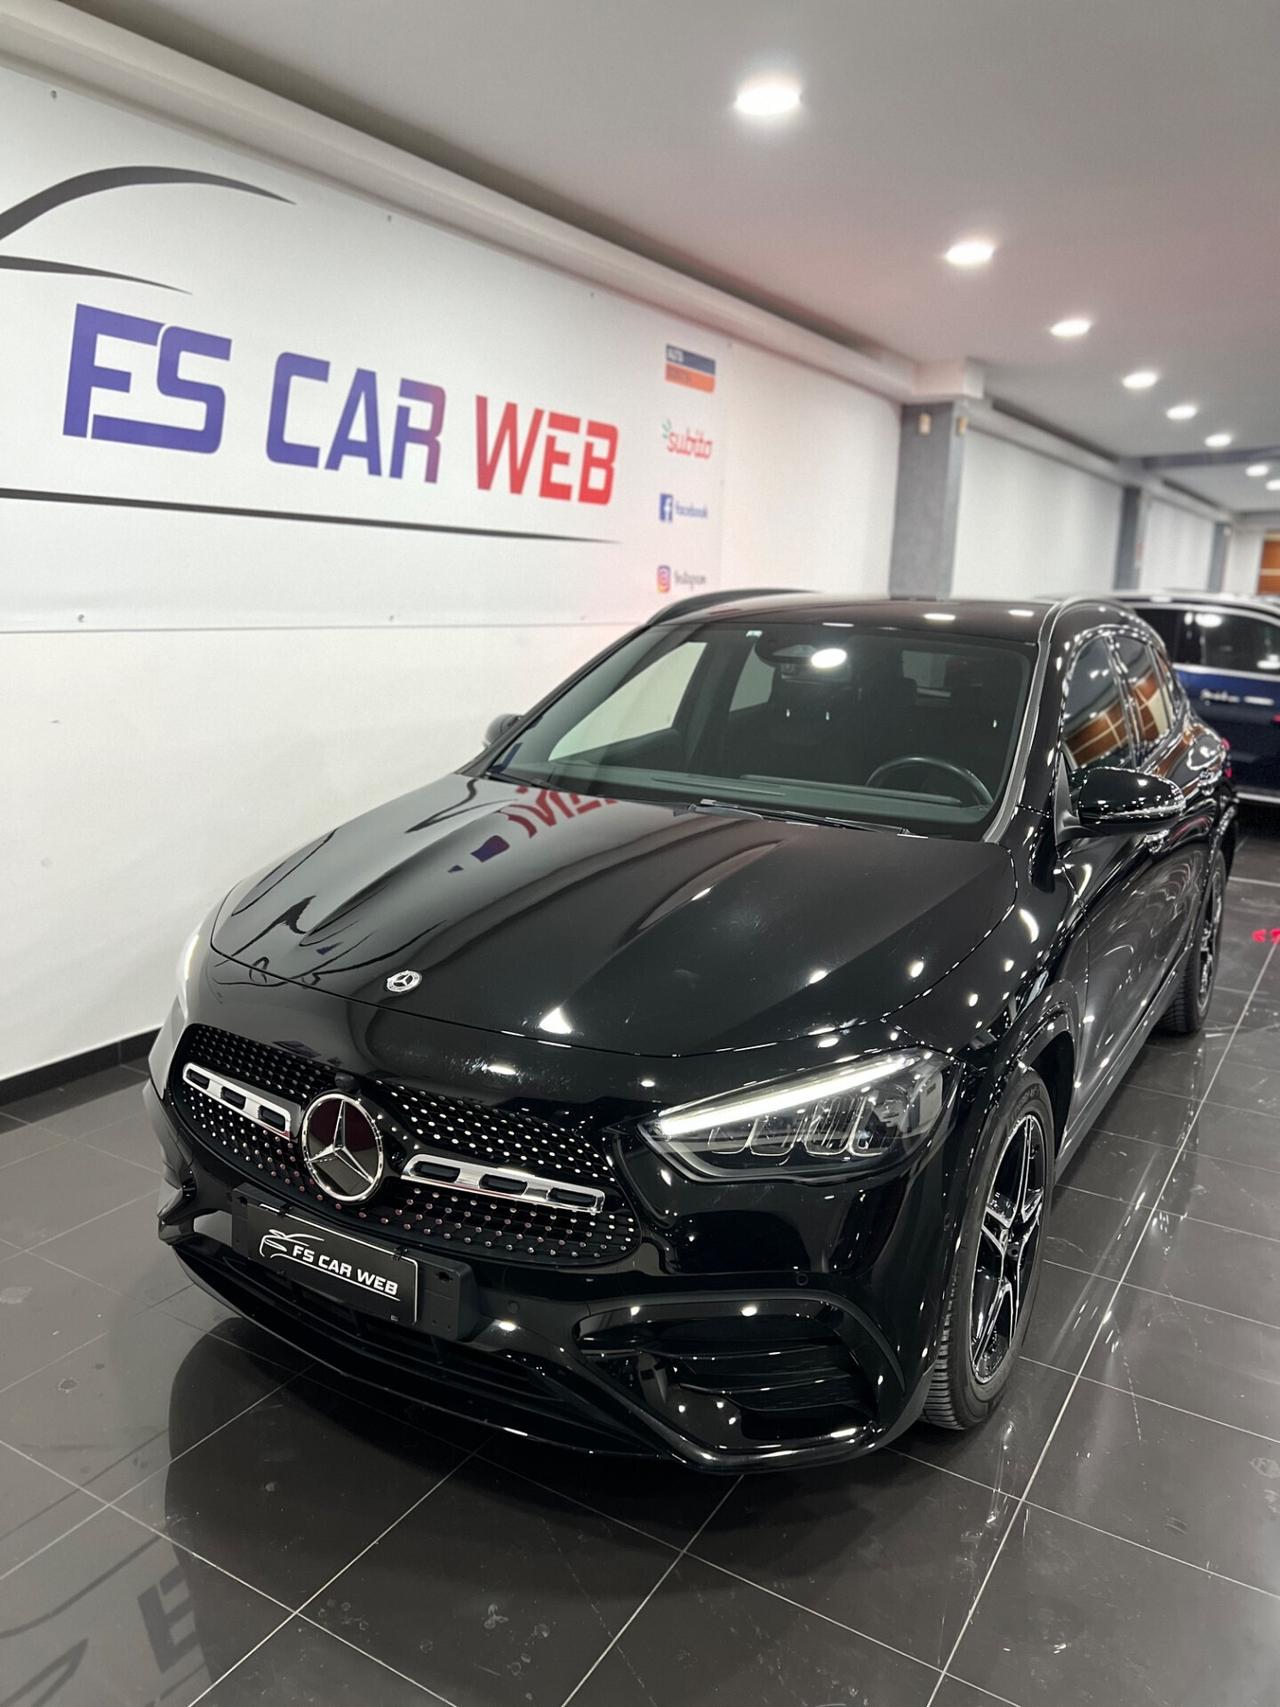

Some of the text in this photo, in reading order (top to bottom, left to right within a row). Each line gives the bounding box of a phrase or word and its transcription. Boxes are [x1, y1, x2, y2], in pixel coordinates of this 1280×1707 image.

[63, 304, 619, 506] FS CAR WEB
[667, 427, 713, 460] subito
[292, 1245, 399, 1296] FS CAR WEB
